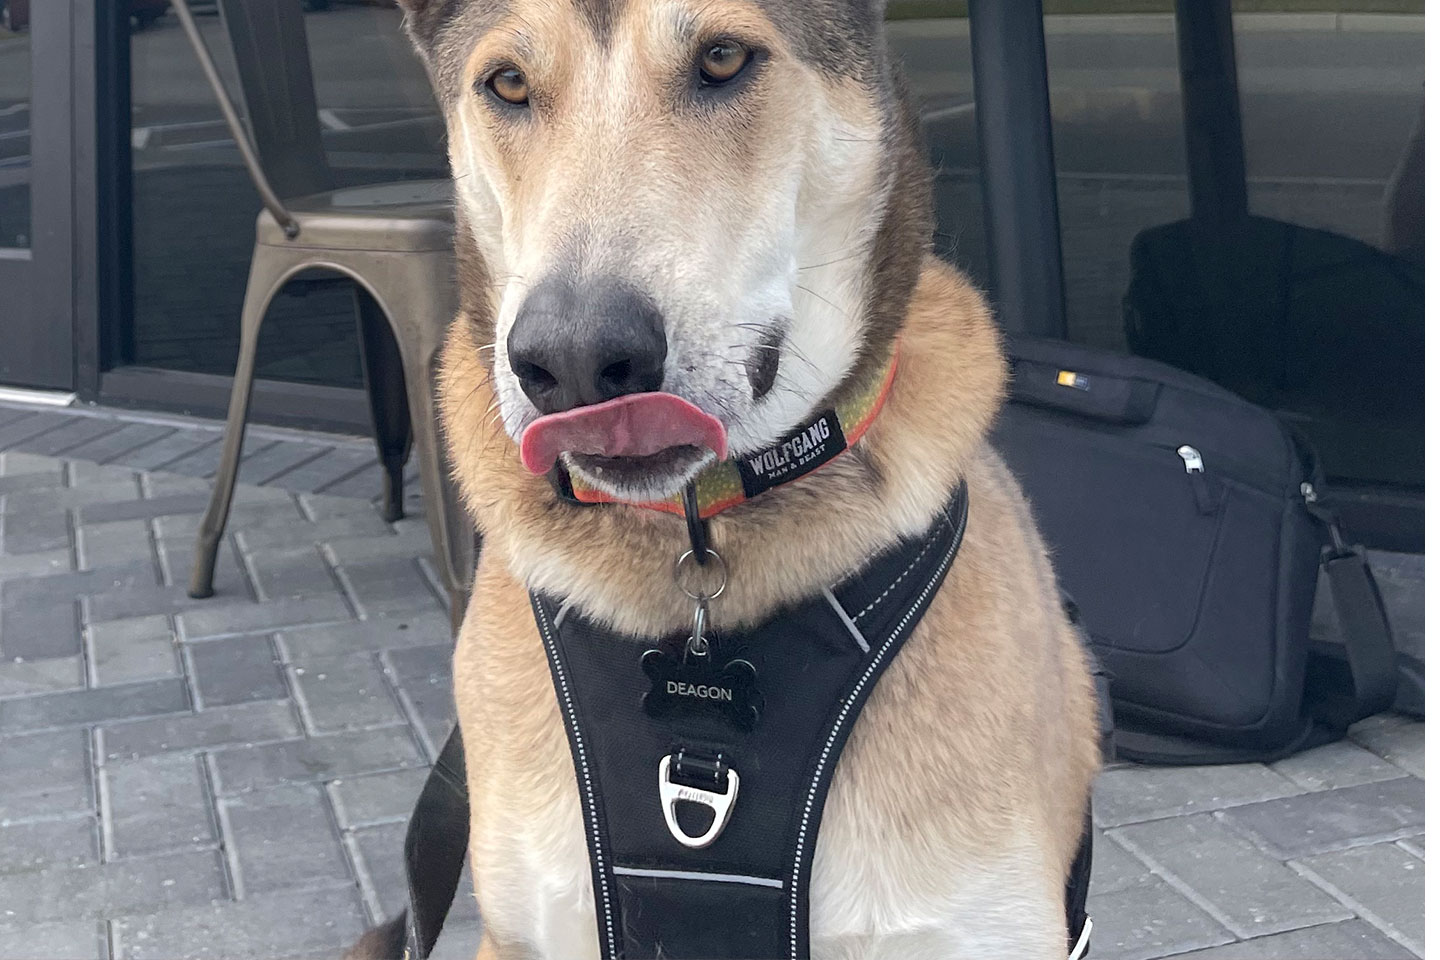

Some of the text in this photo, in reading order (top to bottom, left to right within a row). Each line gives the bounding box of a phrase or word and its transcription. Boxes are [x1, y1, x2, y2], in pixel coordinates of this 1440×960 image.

[749, 417, 831, 476] WOLFGANG
[799, 443, 826, 465] BEAST
[667, 681, 732, 701] DEAGON
